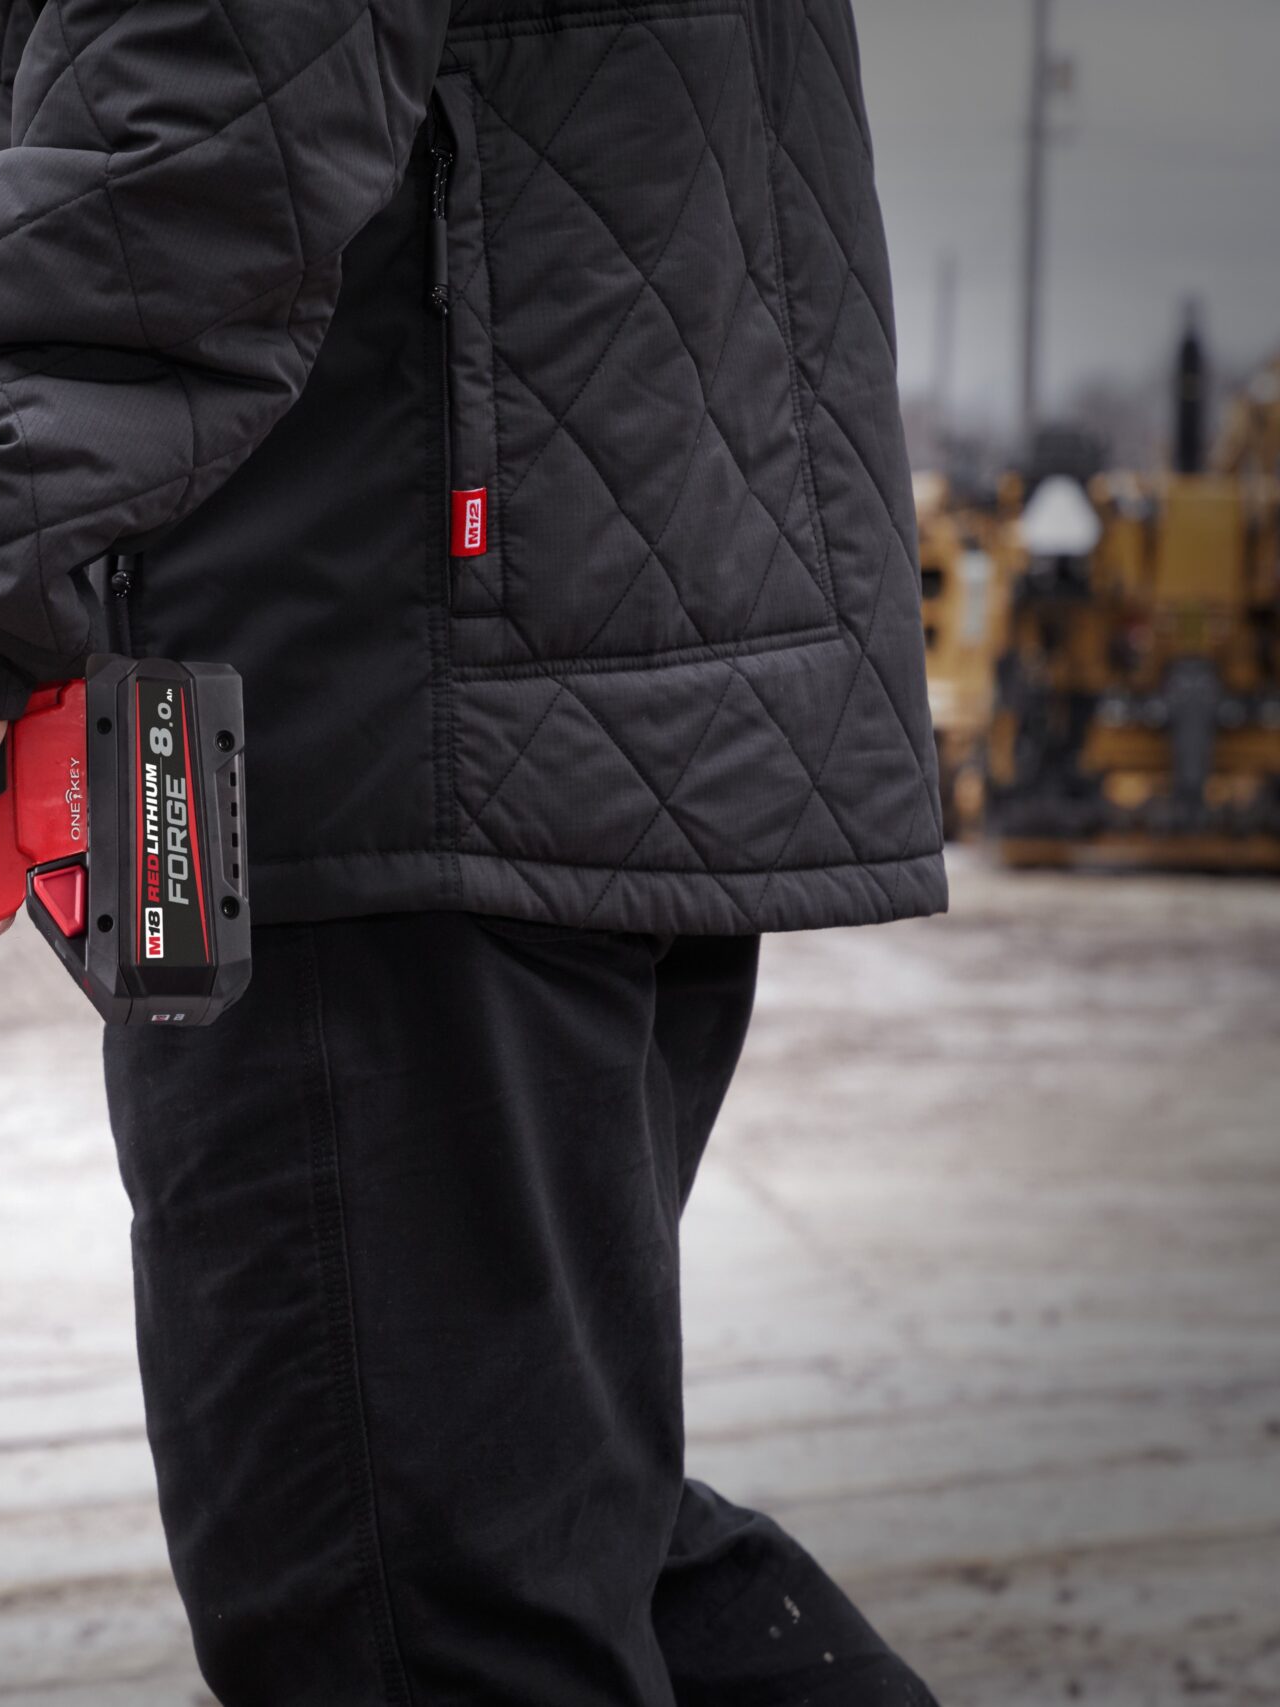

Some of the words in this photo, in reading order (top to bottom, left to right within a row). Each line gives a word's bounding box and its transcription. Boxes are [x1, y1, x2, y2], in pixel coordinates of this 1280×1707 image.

[468, 503, 480, 545] M12
[149, 702, 173, 757] 8.0
[146, 763, 160, 902] REDLITHIUM
[166, 774, 189, 905] FORGE
[148, 910, 161, 955] M18
